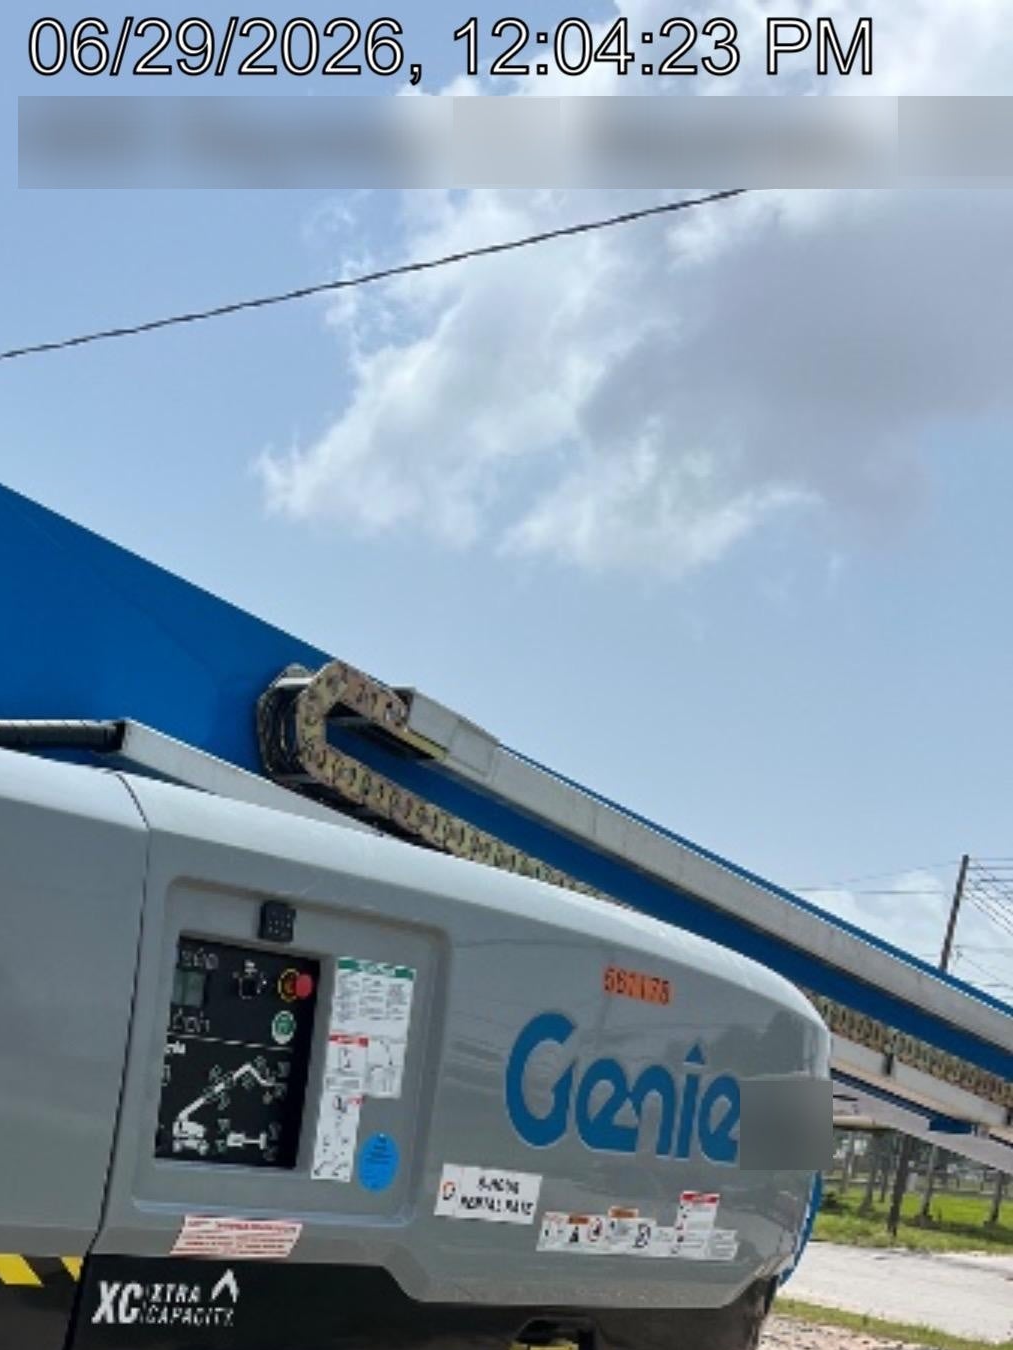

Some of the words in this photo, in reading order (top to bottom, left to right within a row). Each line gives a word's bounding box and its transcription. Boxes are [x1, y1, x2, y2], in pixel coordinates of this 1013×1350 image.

[505, 1012, 740, 1166] Genie
[91, 1280, 144, 1324] XC
[149, 1283, 202, 1303] XTRA
[145, 1304, 235, 1327] CAPACITY
